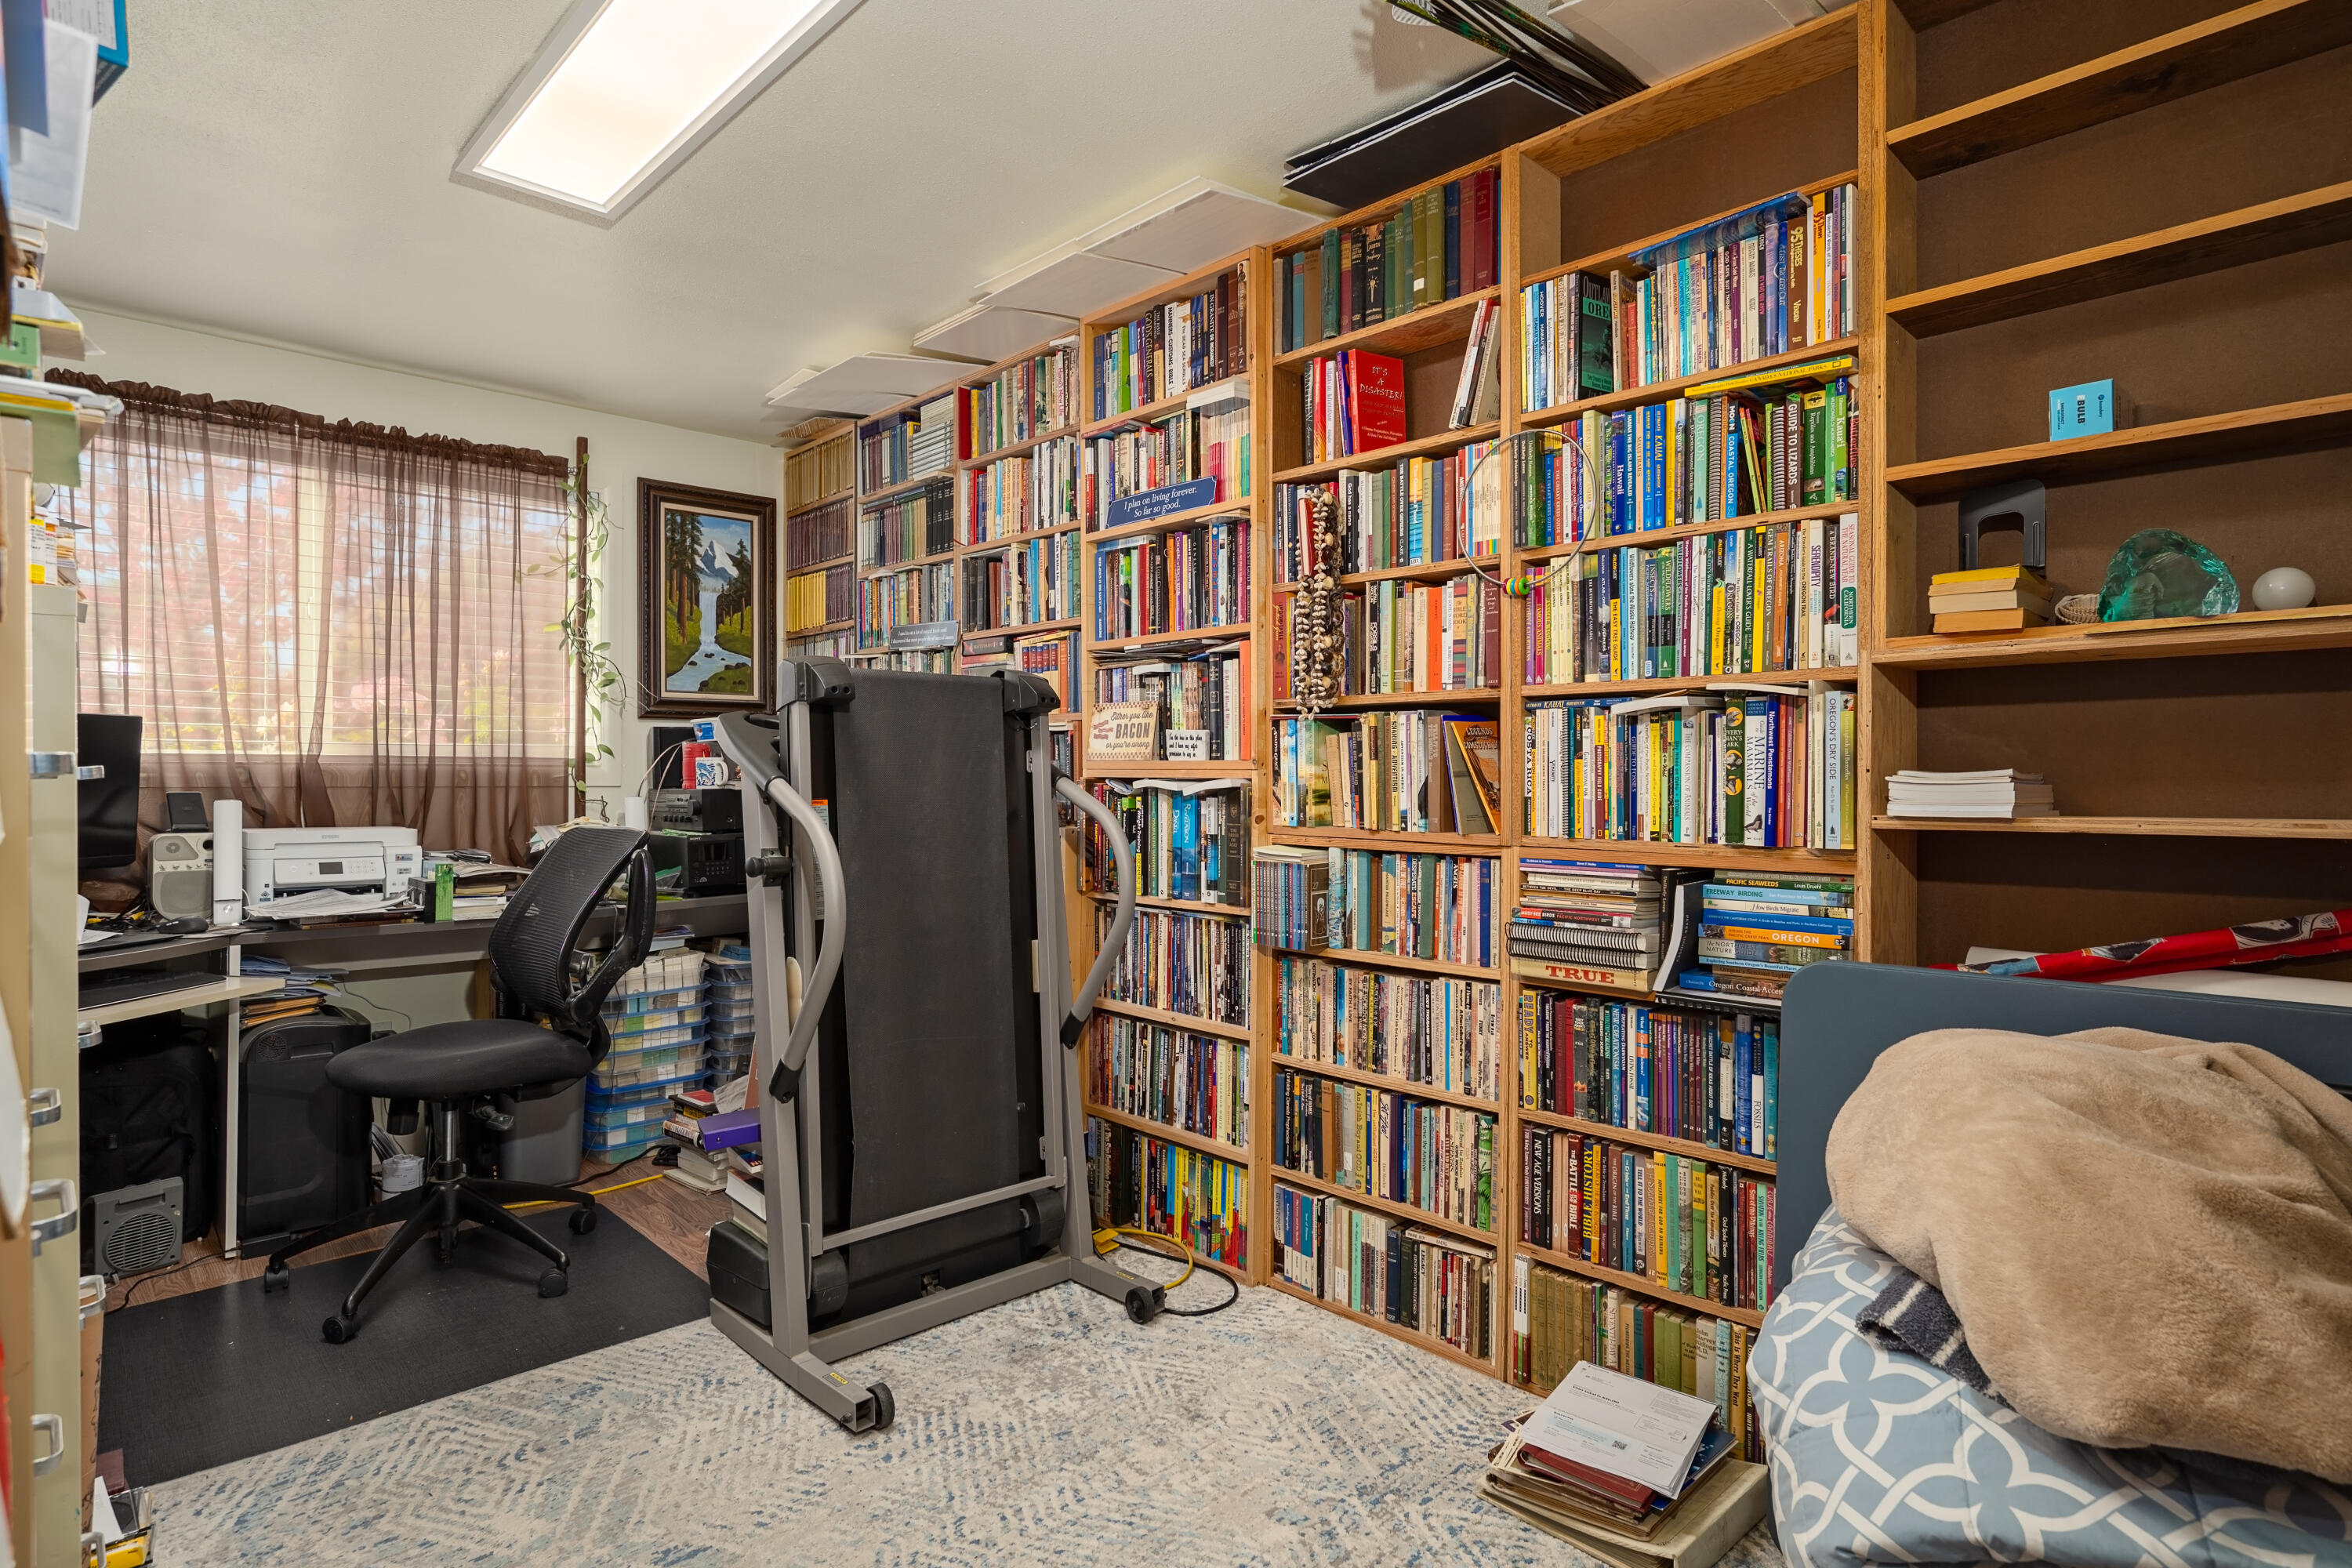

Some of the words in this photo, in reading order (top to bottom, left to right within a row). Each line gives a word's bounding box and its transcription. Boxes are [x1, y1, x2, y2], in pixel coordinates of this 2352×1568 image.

[1791, 227, 1803, 241] 95
[1373, 367, 1387, 376] IT'S
[1359, 383, 1403, 400] DISASTER!
[1788, 404, 1797, 431] GUIDE
[1788, 434, 1797, 442] TO
[1788, 445, 1797, 485] LIZARDS
[1128, 499, 1141, 511] plan
[1152, 493, 1170, 502] living
[1171, 487, 1197, 498] forever.
[1134, 509, 1142, 517] So
[1143, 506, 1152, 515] far
[1162, 499, 1181, 514] good.
[1810, 546, 1820, 586] SERENDIPITY
[1767, 575, 1773, 583] OF
[1849, 575, 1855, 583] TO
[1111, 712, 1128, 720] Either
[1129, 713, 1141, 721] you
[1142, 710, 1153, 719] like
[1116, 722, 1150, 739] BACON
[1755, 737, 1765, 789] MARINE
[1772, 933, 1819, 944] OREGON
[1546, 965, 1614, 984] TRUE
[1709, 981, 1733, 989] Oregon
[1524, 995, 1533, 1033] READY
[1584, 1147, 1592, 1201] HISTORY
[1583, 1203, 1592, 1239] BIBLE
